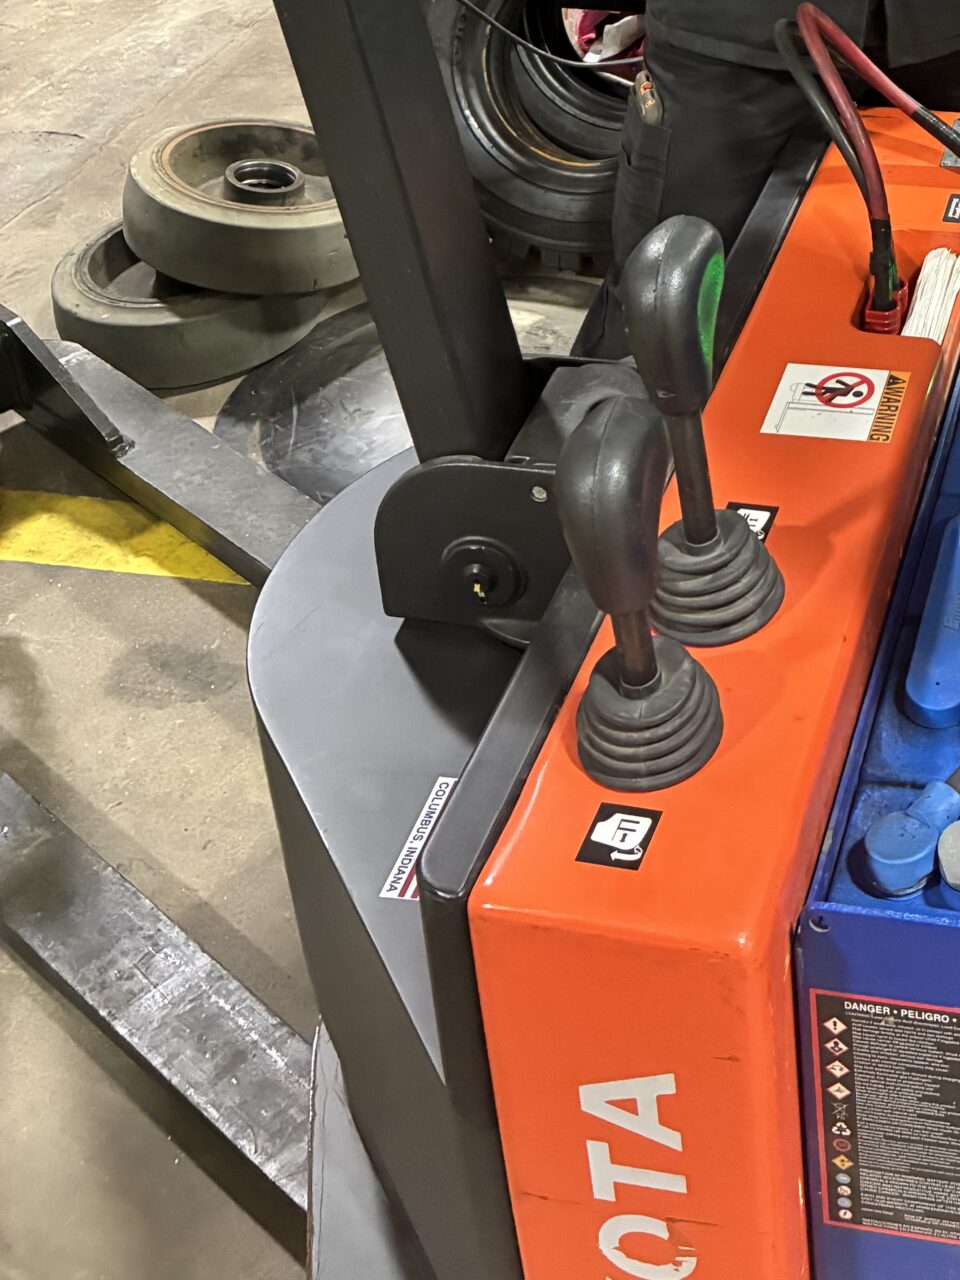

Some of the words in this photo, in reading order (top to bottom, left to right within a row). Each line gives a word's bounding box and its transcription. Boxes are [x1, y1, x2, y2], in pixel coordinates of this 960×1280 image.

[869, 385, 905, 442] WARNING
[409, 782, 449, 844] COLUMBUS,
[386, 847, 418, 892] INDIANA
[844, 1001, 890, 1015] DANGER
[900, 1009, 950, 1023] PELIGRO
[578, 1073, 698, 1280] OTA
